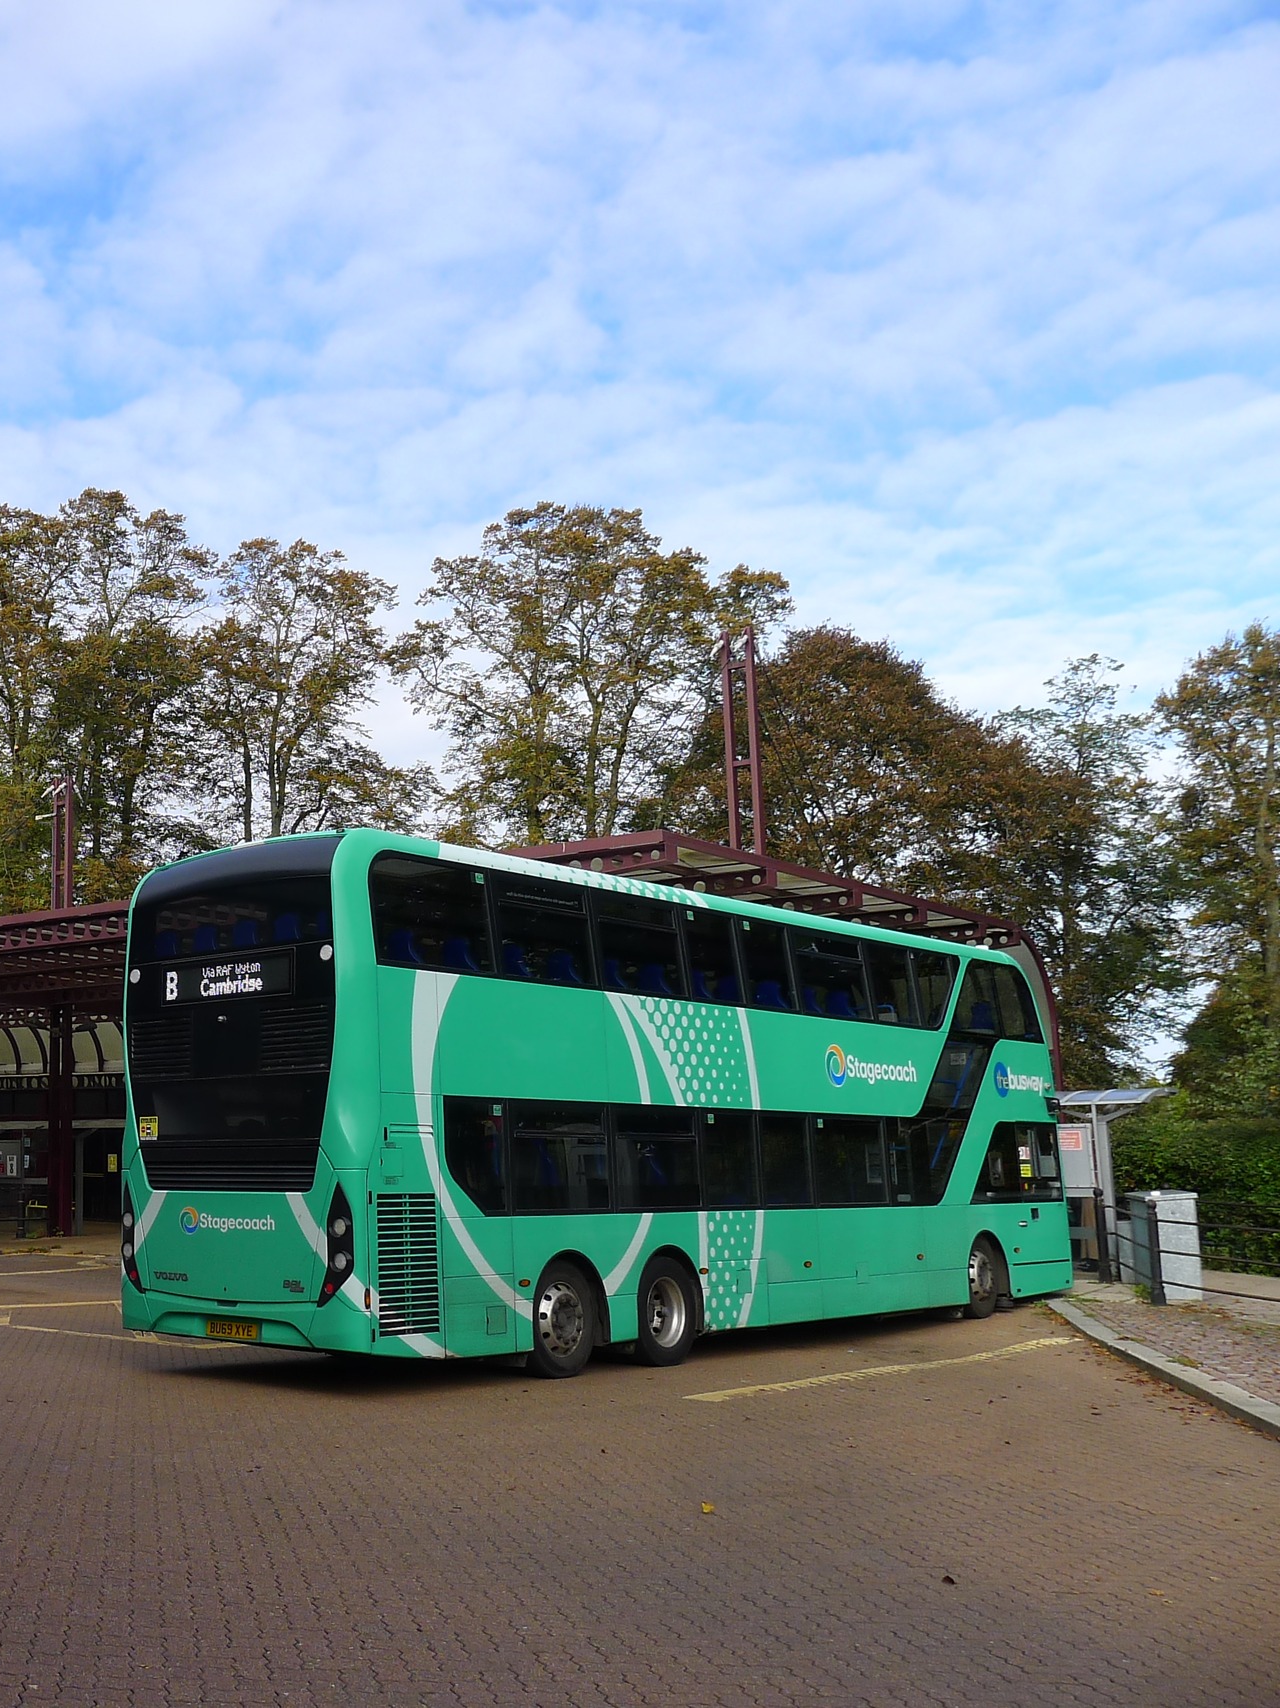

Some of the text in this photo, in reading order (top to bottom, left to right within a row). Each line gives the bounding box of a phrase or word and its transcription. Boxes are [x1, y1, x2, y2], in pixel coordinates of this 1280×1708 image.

[202, 962, 261, 979] Via RAF Wyton
[166, 971, 179, 1001] B
[200, 974, 263, 997] Cambridge
[846, 1054, 917, 1085] Stagecoach
[199, 1213, 276, 1233] Stagecoach
[153, 1270, 189, 1282] VOLVO
[209, 1322, 253, 1337] BU69 XYE
